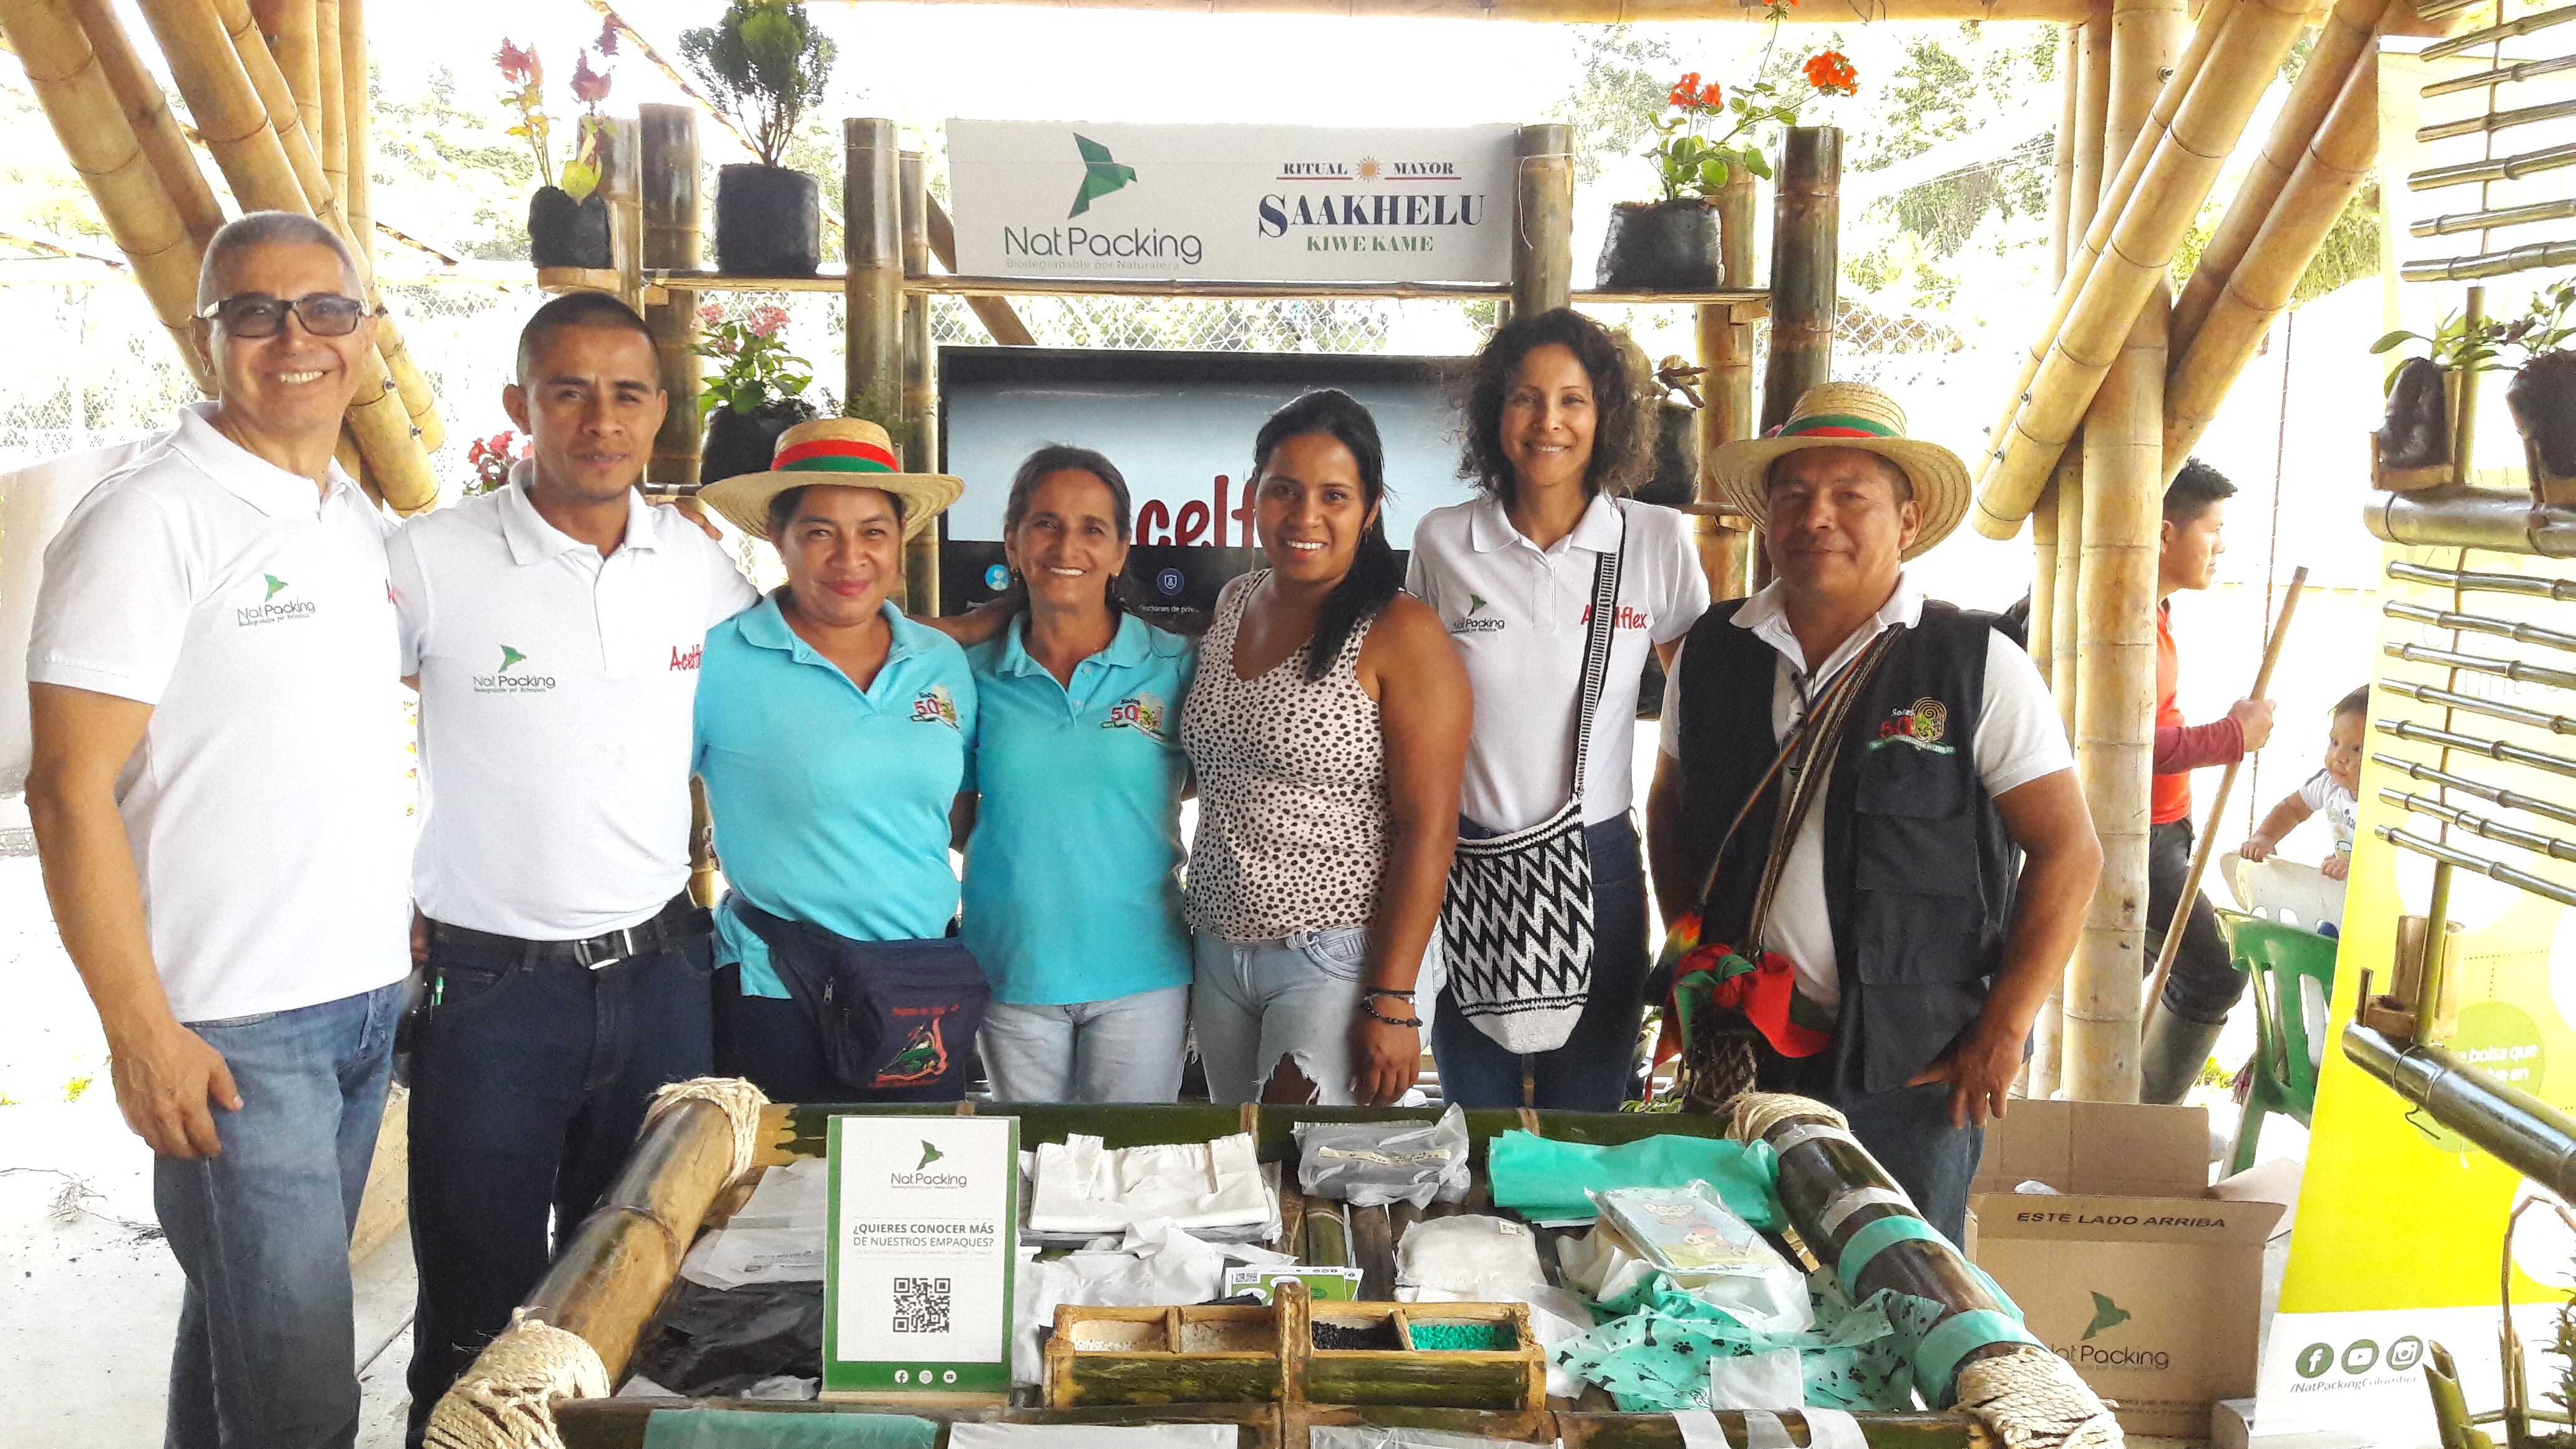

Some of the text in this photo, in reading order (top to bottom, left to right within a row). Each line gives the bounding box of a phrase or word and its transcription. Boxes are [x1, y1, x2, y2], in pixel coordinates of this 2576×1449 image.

[1283, 162, 1455, 175] RITUAL MAYOR
[1258, 193, 1487, 239] SAAKHELU
[1307, 235, 1433, 251] KIWE KAME
[1005, 258, 1179, 271] Biodegradable por Naturaleza
[1580, 603, 1647, 630] Alflex
[1111, 705, 1139, 723] 50
[2016, 1212, 2227, 1227] ESTE LADO ARRIBA
[852, 1222, 995, 1235] ¿QUIERES CONOCER MÁS
[853, 1236, 994, 1249] DE NUESTROS EMPAQUES?
